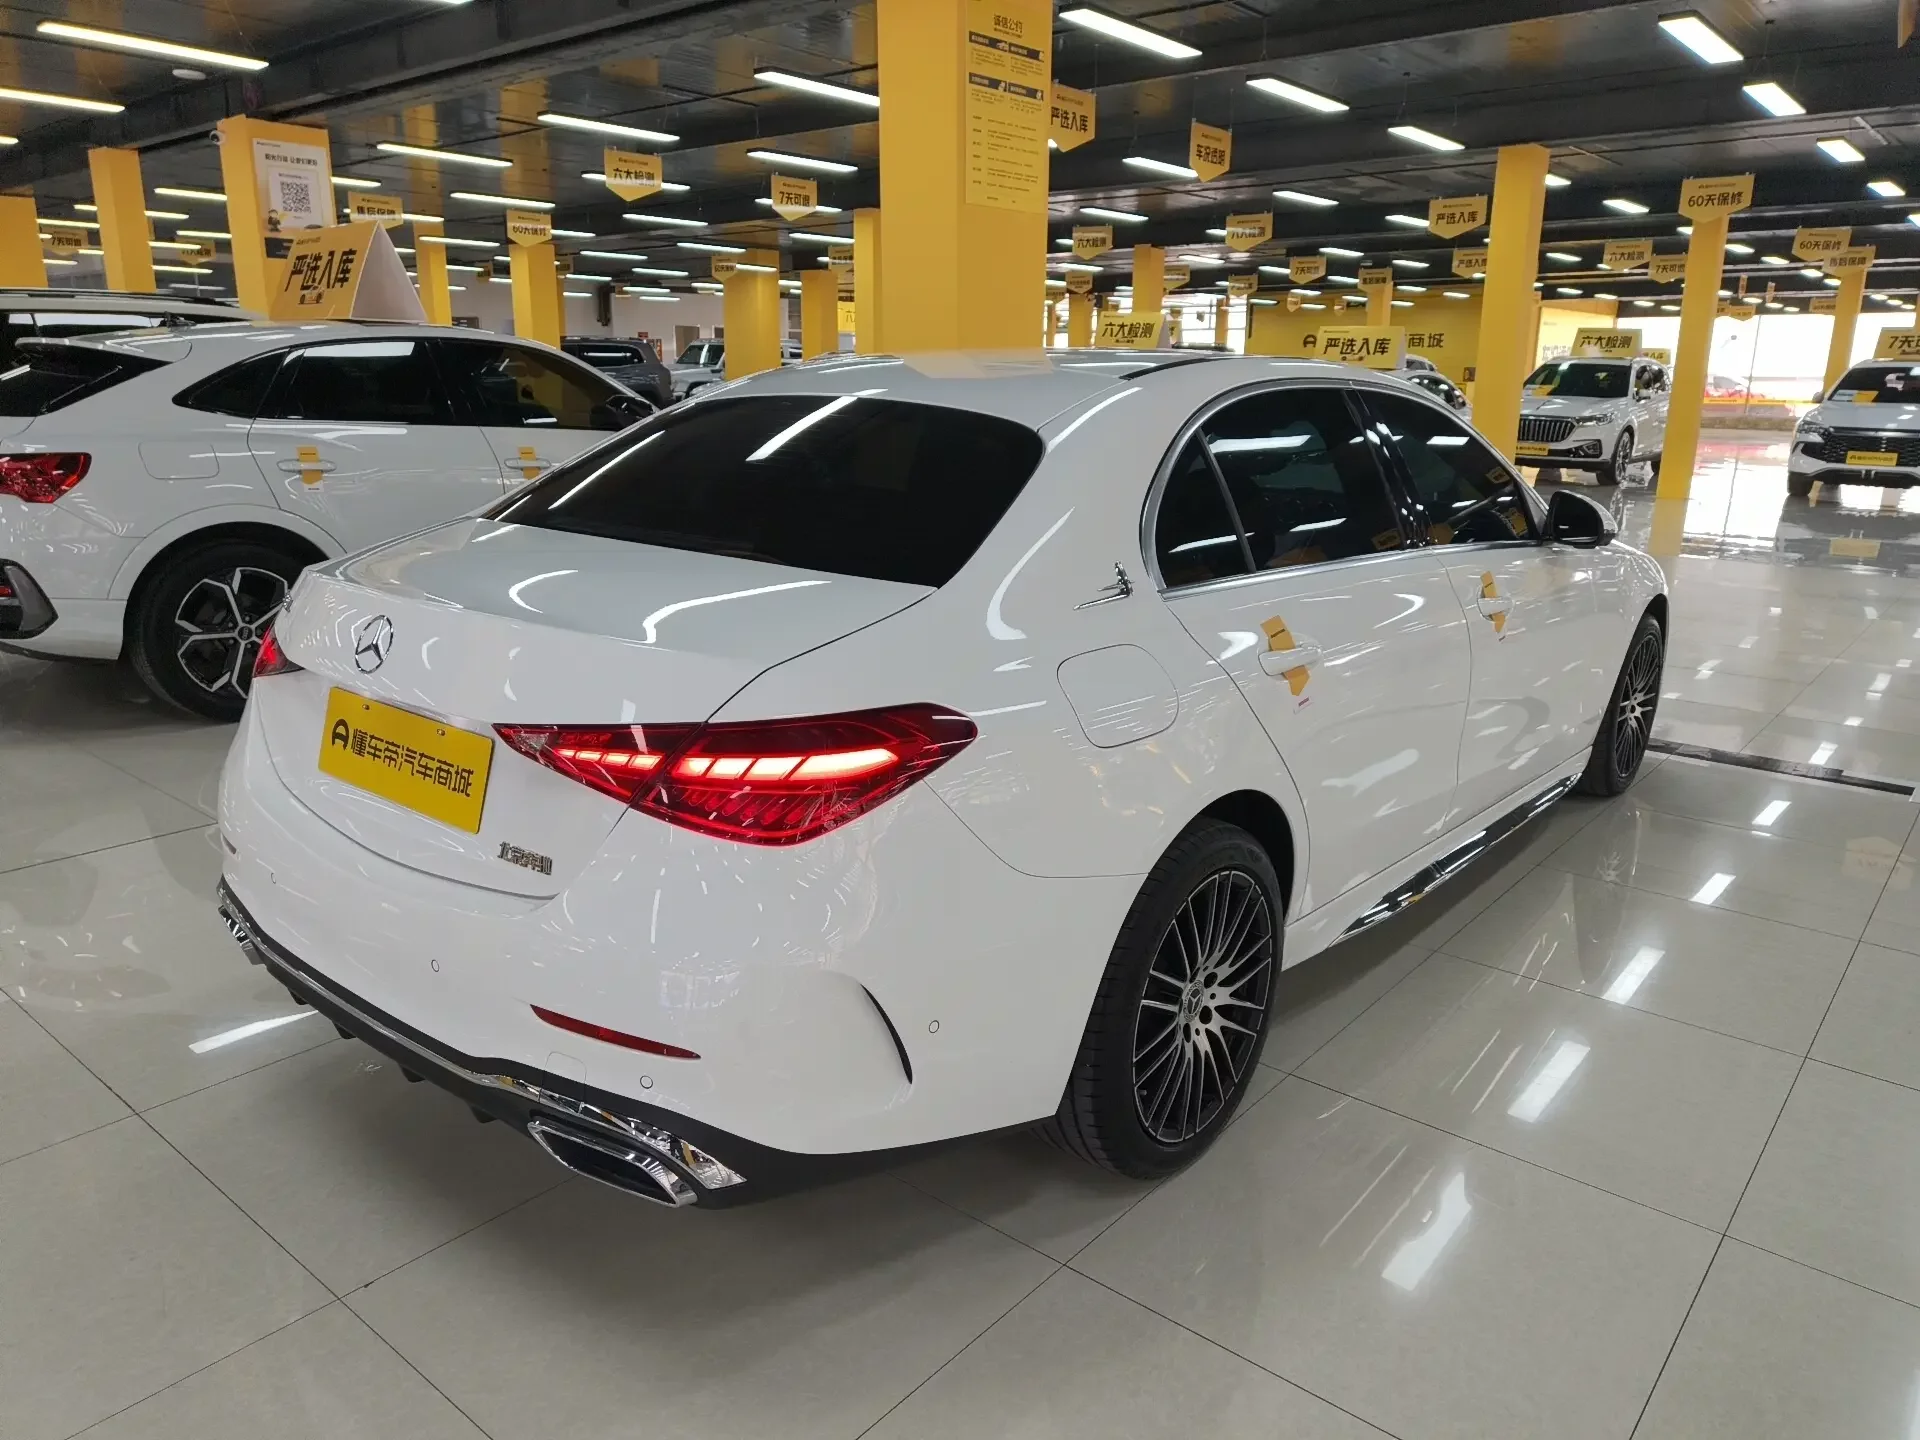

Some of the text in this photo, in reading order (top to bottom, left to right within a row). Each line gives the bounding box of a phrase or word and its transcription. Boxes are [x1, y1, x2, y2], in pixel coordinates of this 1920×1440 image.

[1051, 106, 1089, 133] 严选入库
[1196, 143, 1226, 166] 车况透明
[613, 167, 655, 186] 六大检测
[1688, 191, 1744, 208] 60天保修
[1435, 211, 1478, 225] 严选入库
[1800, 241, 1842, 251] 60天保修
[1609, 250, 1645, 262] 六大检测
[285, 249, 357, 292] 严选入库
[1102, 321, 1156, 339] 六大检测
[1322, 337, 1392, 356] 严选入库
[1407, 332, 1445, 349] 商城
[1579, 335, 1633, 349] 六大检测
[351, 727, 475, 799] 懂车帝汽车商城
